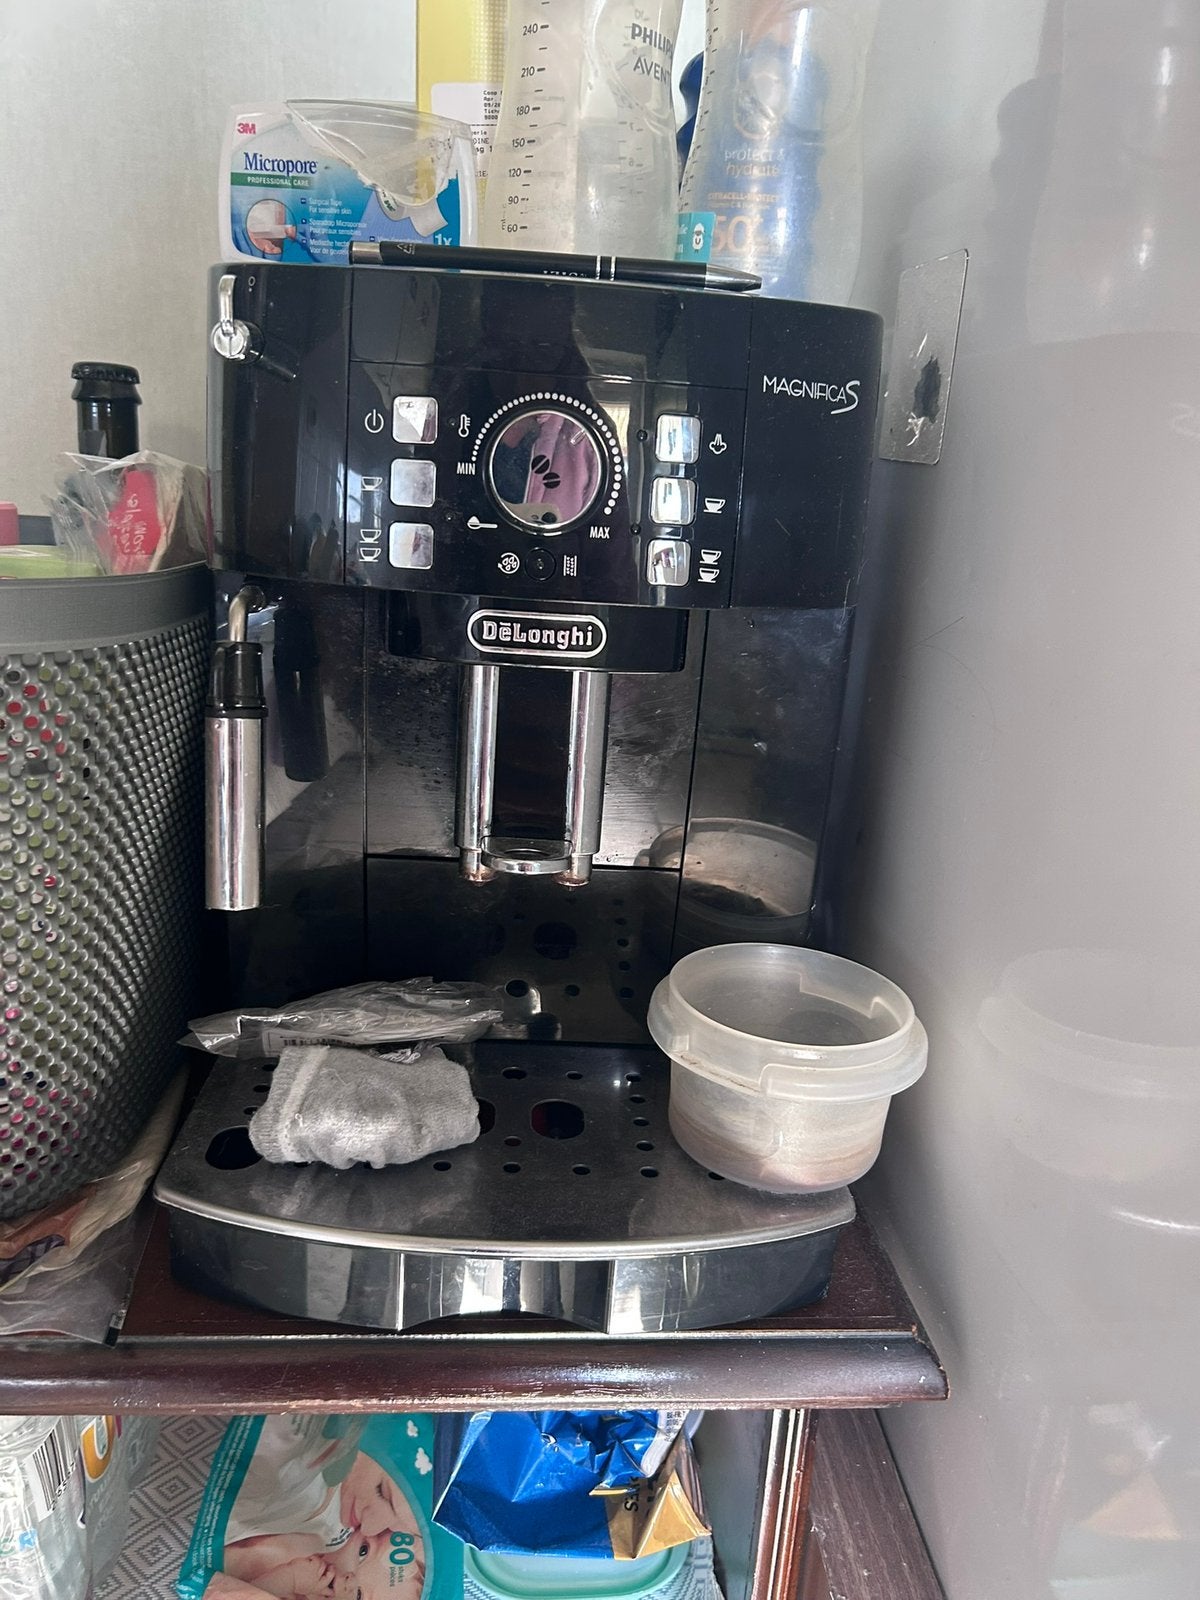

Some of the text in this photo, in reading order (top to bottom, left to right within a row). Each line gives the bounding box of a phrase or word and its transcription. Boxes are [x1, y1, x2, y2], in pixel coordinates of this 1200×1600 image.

[522, 23, 538, 36] 240
[521, 66, 535, 78] 210
[516, 105, 530, 116] 180
[237, 122, 256, 135] 3M
[512, 137, 525, 148] 150
[243, 152, 318, 177] Micropore
[508, 167, 521, 177] 120
[247, 175, 309, 187] PROFESSIONAL CARE
[508, 195, 519, 205] 90
[507, 223, 518, 233] 60
[456, 462, 475, 475] MIN
[590, 526, 610, 539] MAX
[390, 1532, 414, 1565] 80
